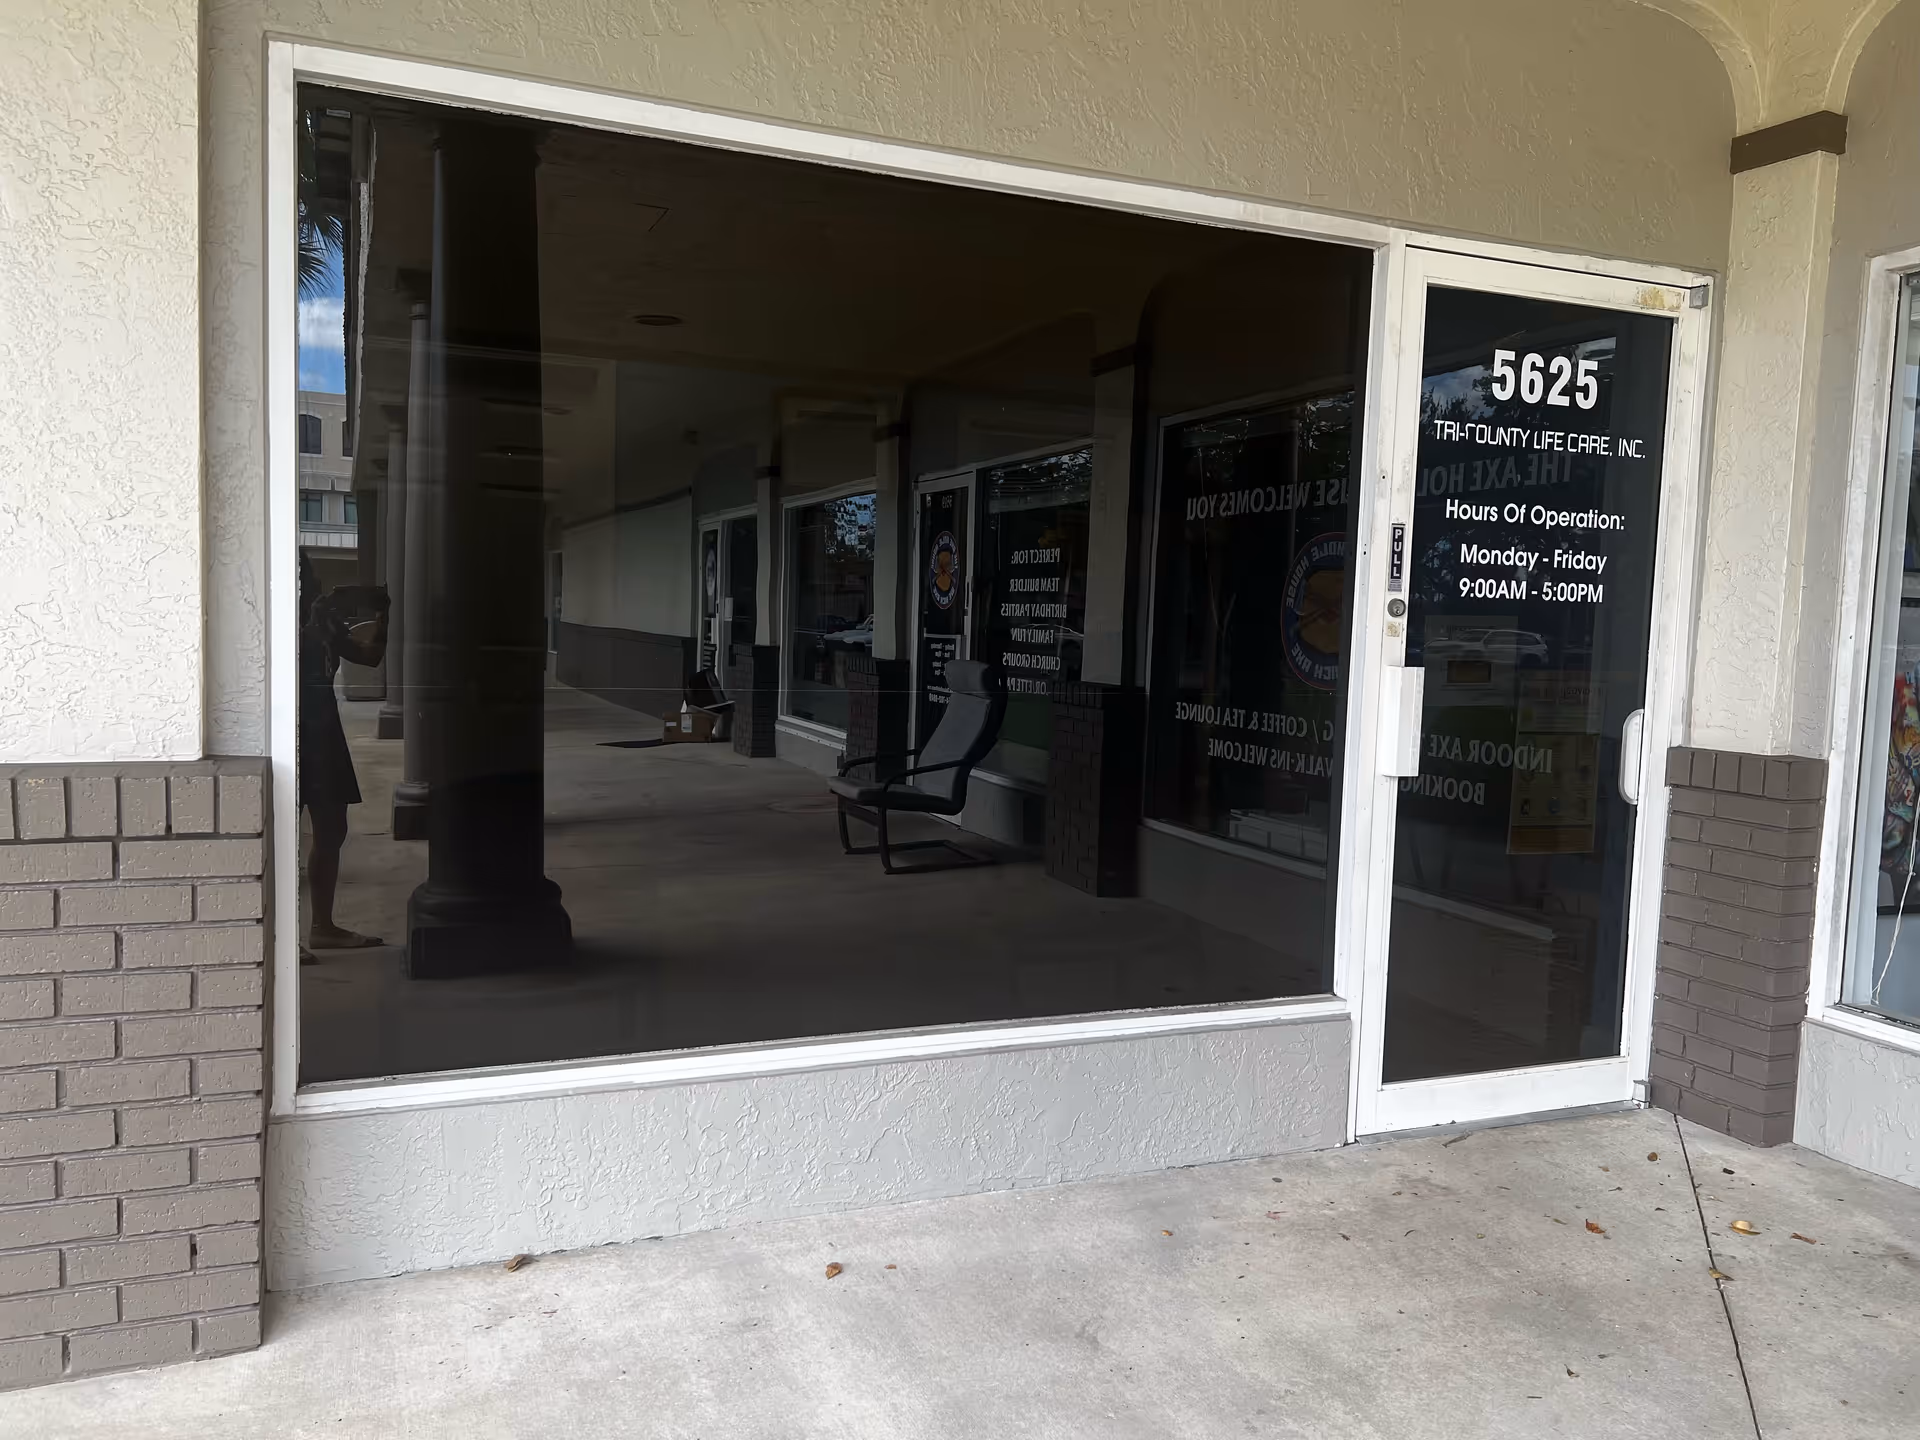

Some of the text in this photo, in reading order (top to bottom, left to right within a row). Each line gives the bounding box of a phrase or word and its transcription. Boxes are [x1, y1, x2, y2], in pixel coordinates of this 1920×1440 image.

[1491, 348, 1599, 410] 5625
[1533, 430, 1564, 451] LIFE
[1617, 438, 1646, 459] INC.
[1445, 498, 1625, 530] Hours Of Operation:
[1393, 529, 1402, 577] PULL
[1460, 543, 1539, 572] Monday
[1553, 549, 1608, 575] Friday
[1459, 577, 1526, 600] 9:00AM
[1541, 582, 1603, 603] 5:00PM
